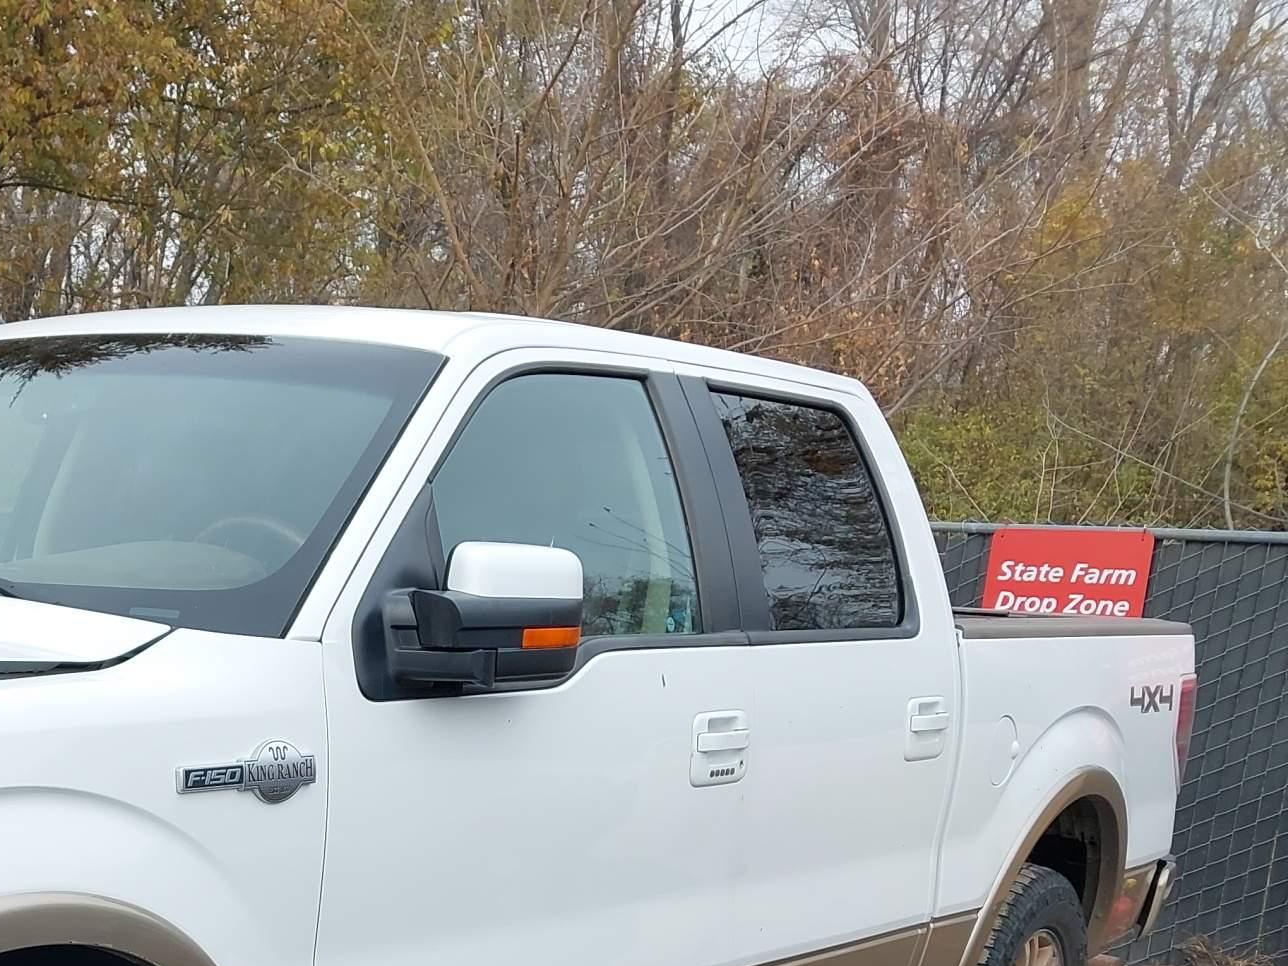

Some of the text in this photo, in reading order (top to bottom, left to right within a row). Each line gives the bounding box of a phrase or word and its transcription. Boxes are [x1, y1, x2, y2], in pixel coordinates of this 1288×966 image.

[997, 560, 1136, 586] State Farm
[995, 591, 1129, 616] Drop Zone
[246, 761, 275, 782] KING
[277, 758, 313, 779] RANCH
